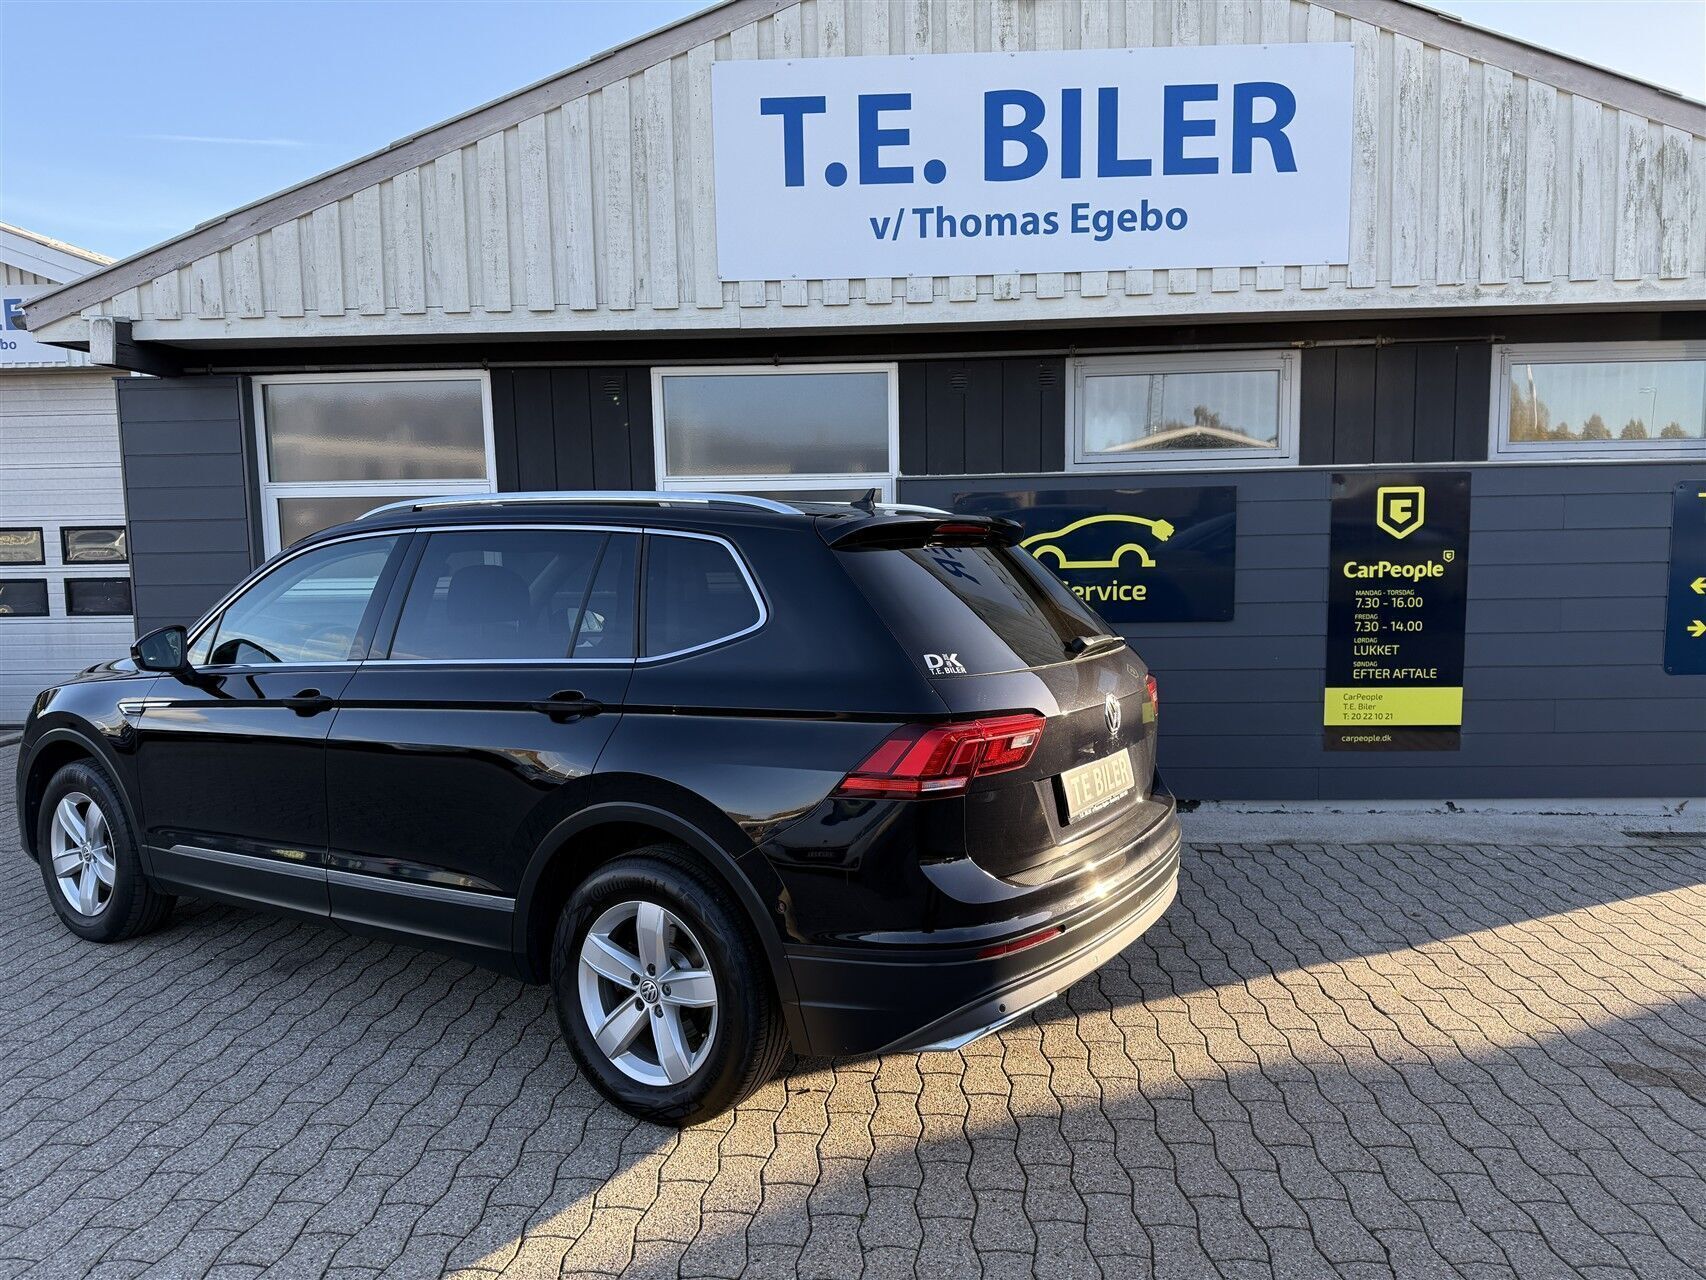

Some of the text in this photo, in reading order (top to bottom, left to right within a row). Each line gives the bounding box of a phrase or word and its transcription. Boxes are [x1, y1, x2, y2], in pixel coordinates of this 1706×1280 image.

[760, 81, 1298, 188] T.E. BILER
[869, 199, 1189, 242] v/ Thomas Egebo
[1343, 560, 1444, 583] CarPeople
[1062, 579, 1147, 601] ervice
[1355, 597, 1380, 609] 7.30
[1391, 597, 1424, 608] 16.00
[1354, 621, 1379, 632] 7.30
[1390, 620, 1423, 632] 14.00
[1353, 644, 1400, 656] LUKKET
[1353, 668, 1438, 679] EFTER AFTALE
[1343, 693, 1384, 702] CarPeople
[1343, 702, 1377, 711] T.E. Biler
[1343, 712, 1394, 720] T: 20 22 10 21
[1341, 734, 1392, 743] carpeople.dk
[1093, 757, 1129, 797] BILER
